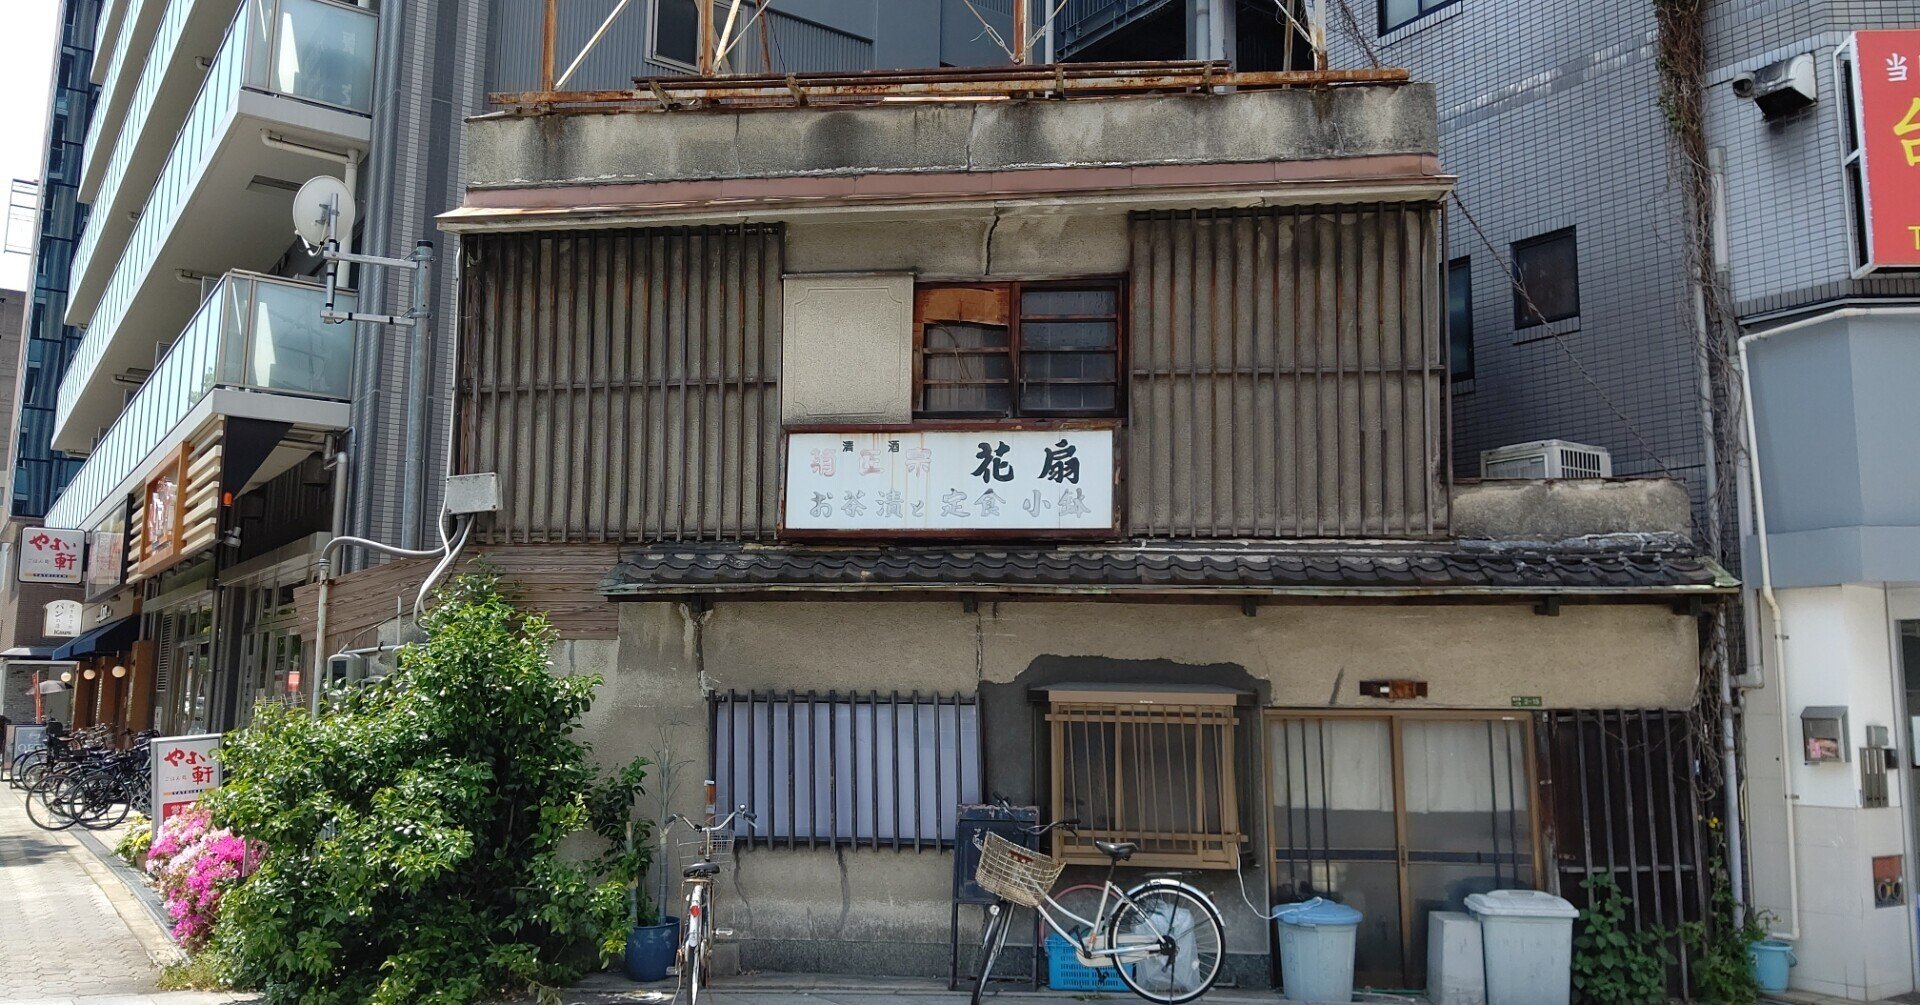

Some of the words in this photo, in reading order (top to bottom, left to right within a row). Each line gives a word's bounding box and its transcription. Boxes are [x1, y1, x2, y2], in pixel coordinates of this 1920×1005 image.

[810, 447, 932, 478] 菊正宗
[971, 438, 1081, 485] 花扇
[28, 532, 77, 551] やよい
[54, 552, 77, 571] 軒
[164, 747, 213, 768] やよい
[192, 766, 214, 785] 軒
